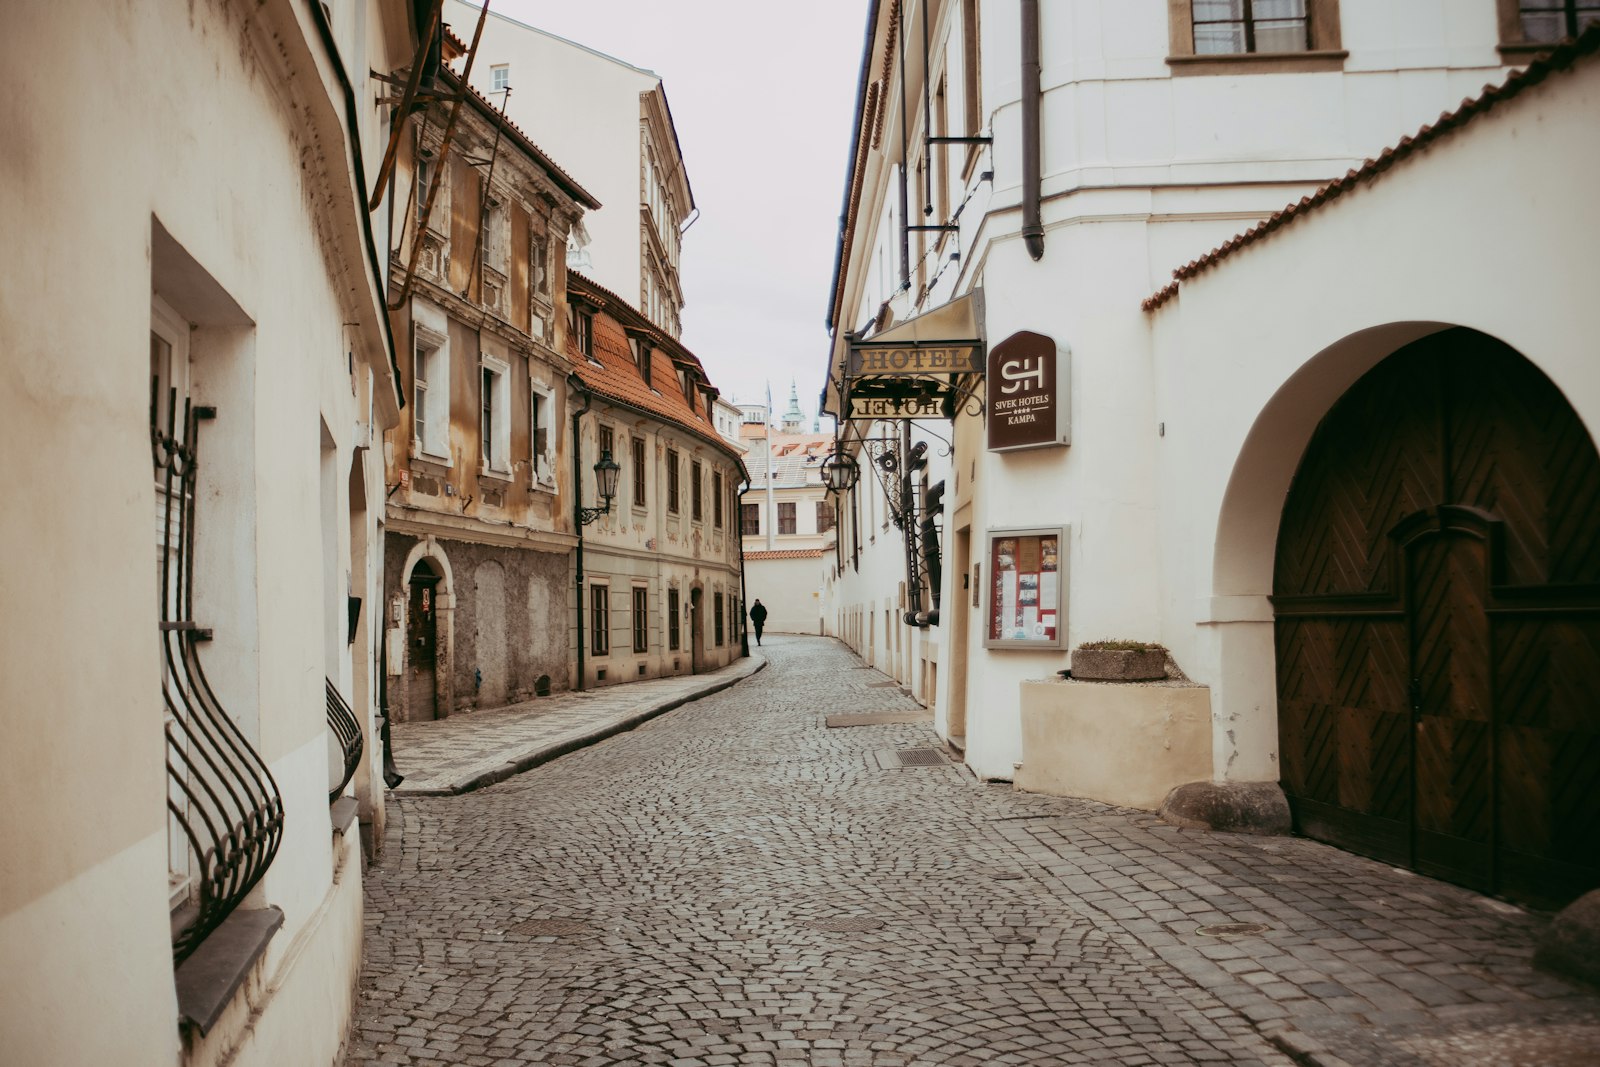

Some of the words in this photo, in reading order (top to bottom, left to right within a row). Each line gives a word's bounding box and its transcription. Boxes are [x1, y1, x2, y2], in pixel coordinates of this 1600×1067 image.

[867, 350, 967, 369] HOTEL
[1001, 357, 1043, 394] SH
[995, 399, 1017, 410] SIVEK
[1018, 395, 1049, 407] HOTELS
[1008, 414, 1036, 425] KAMPA
